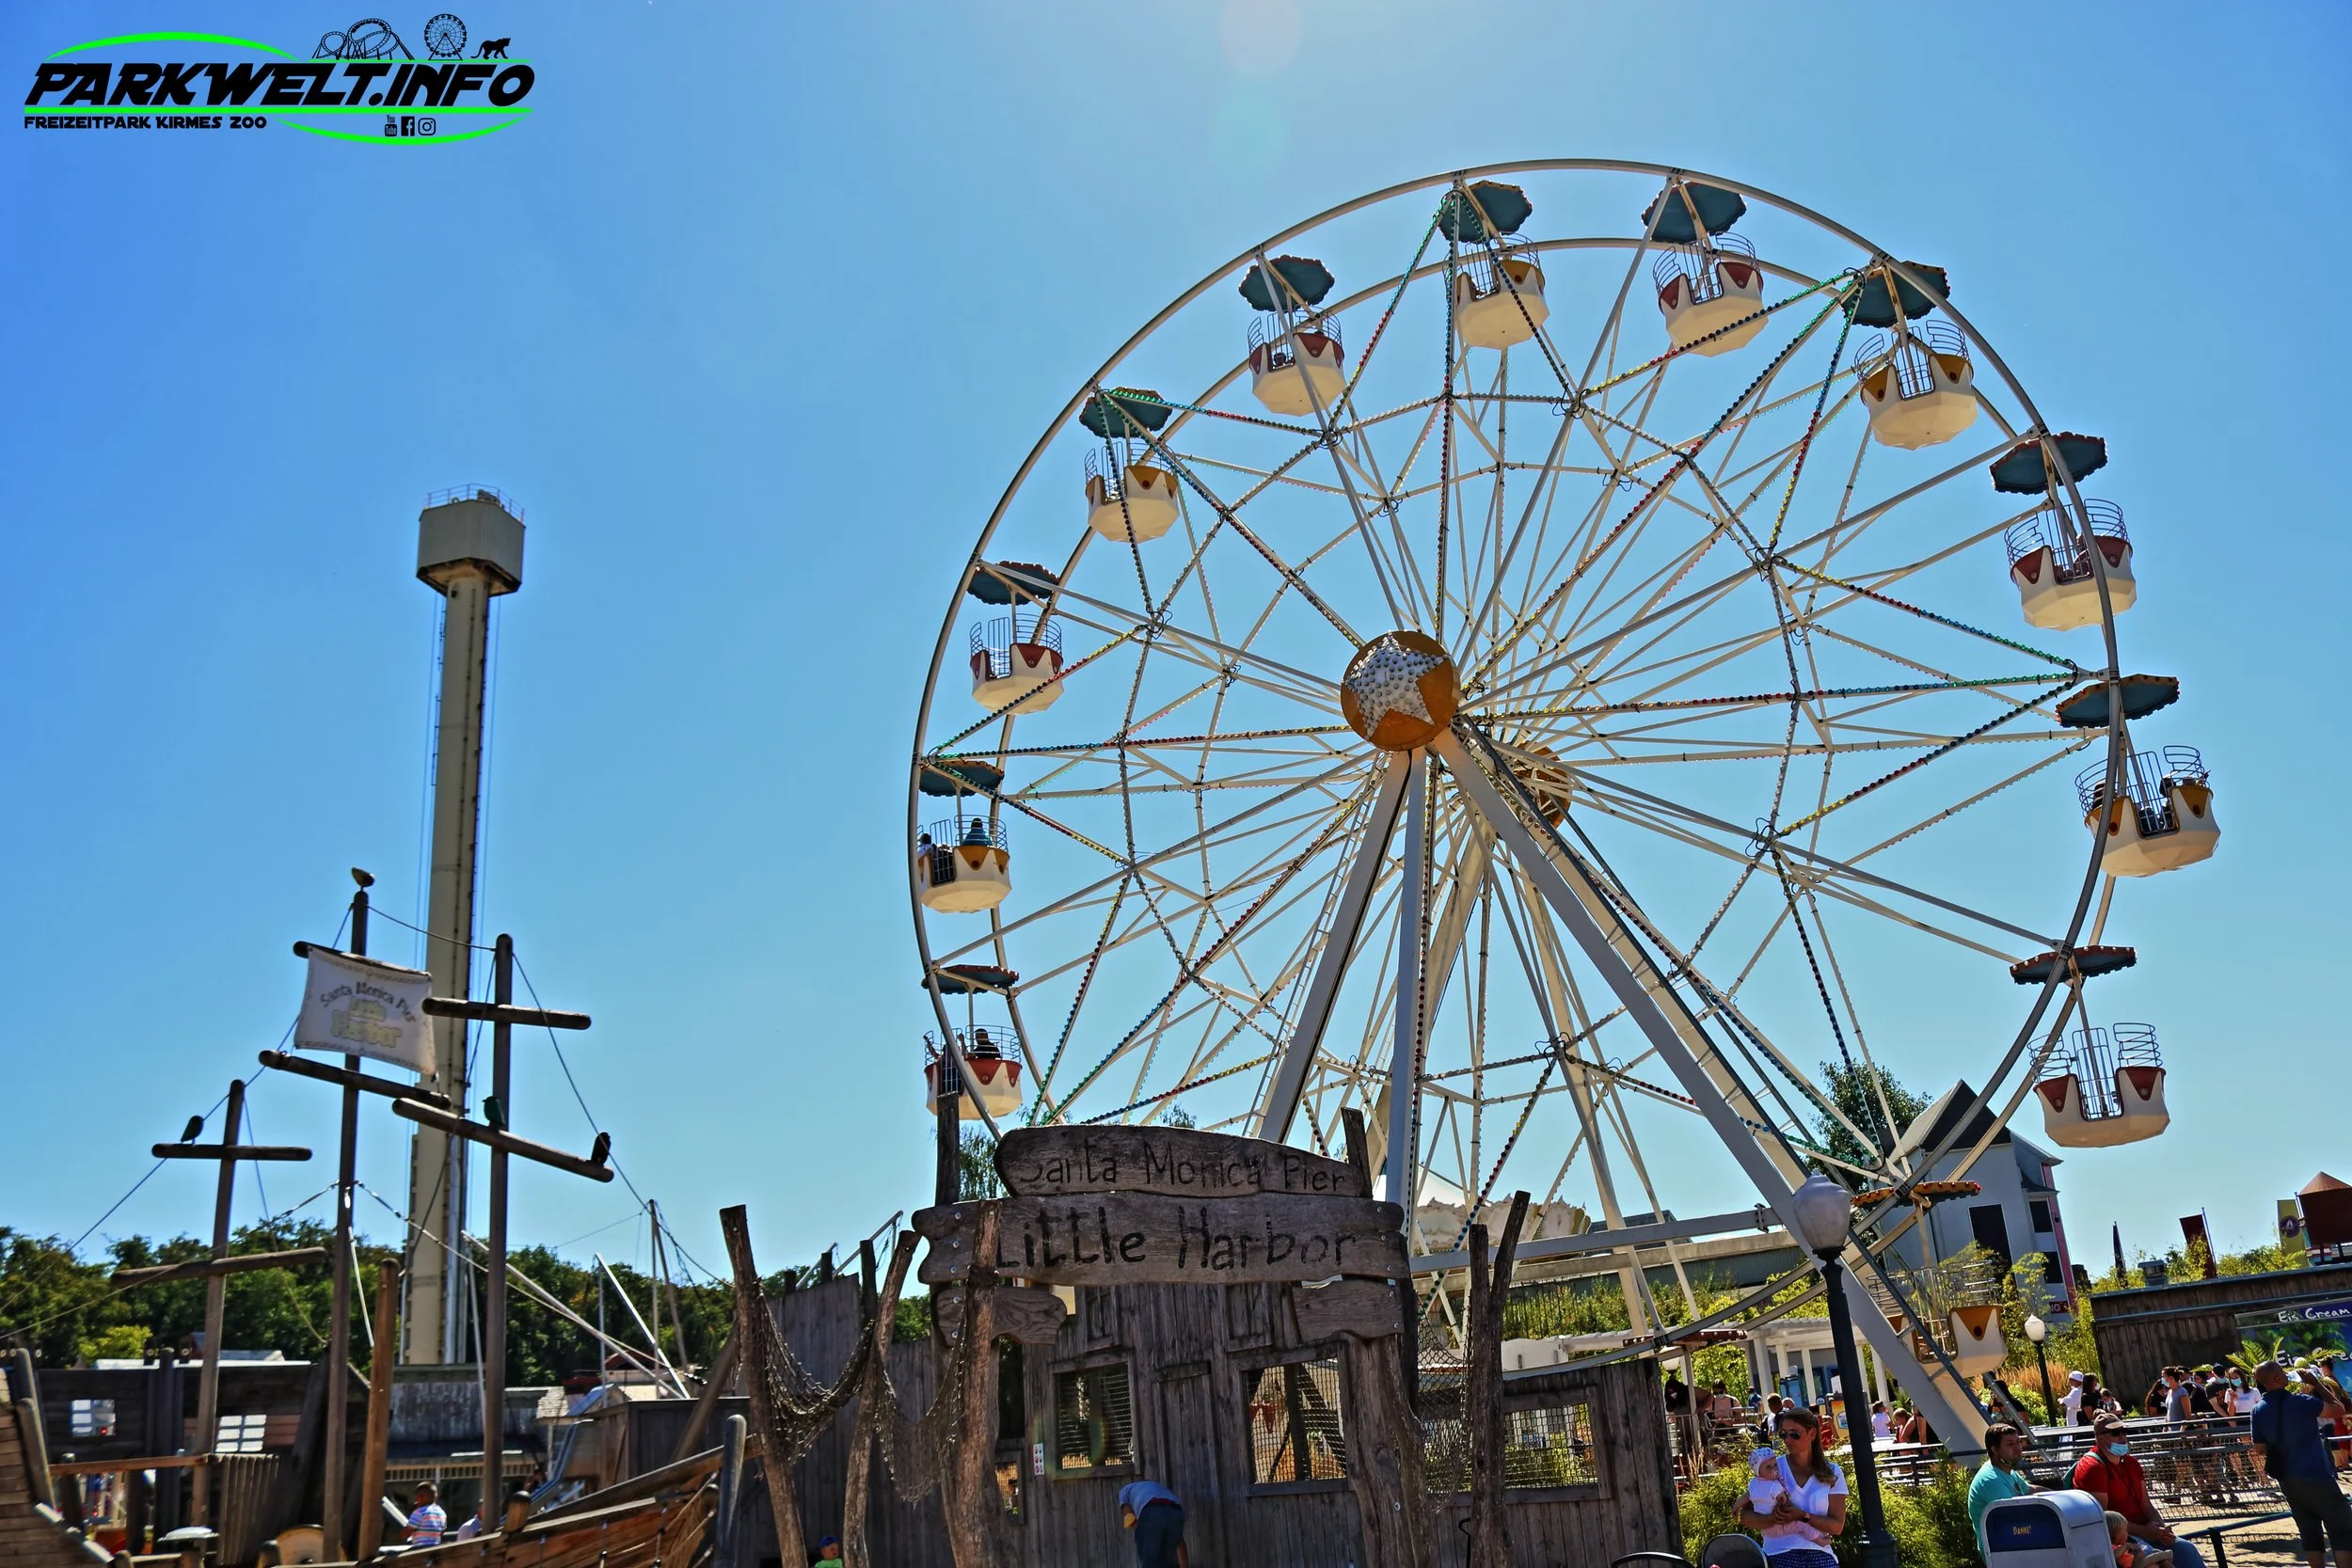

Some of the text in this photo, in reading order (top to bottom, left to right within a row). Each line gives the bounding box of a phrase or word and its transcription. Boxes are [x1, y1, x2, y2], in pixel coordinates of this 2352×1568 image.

[1281, 1150, 1345, 1192] Pier
[995, 1205, 1357, 1271] Little Harbor
